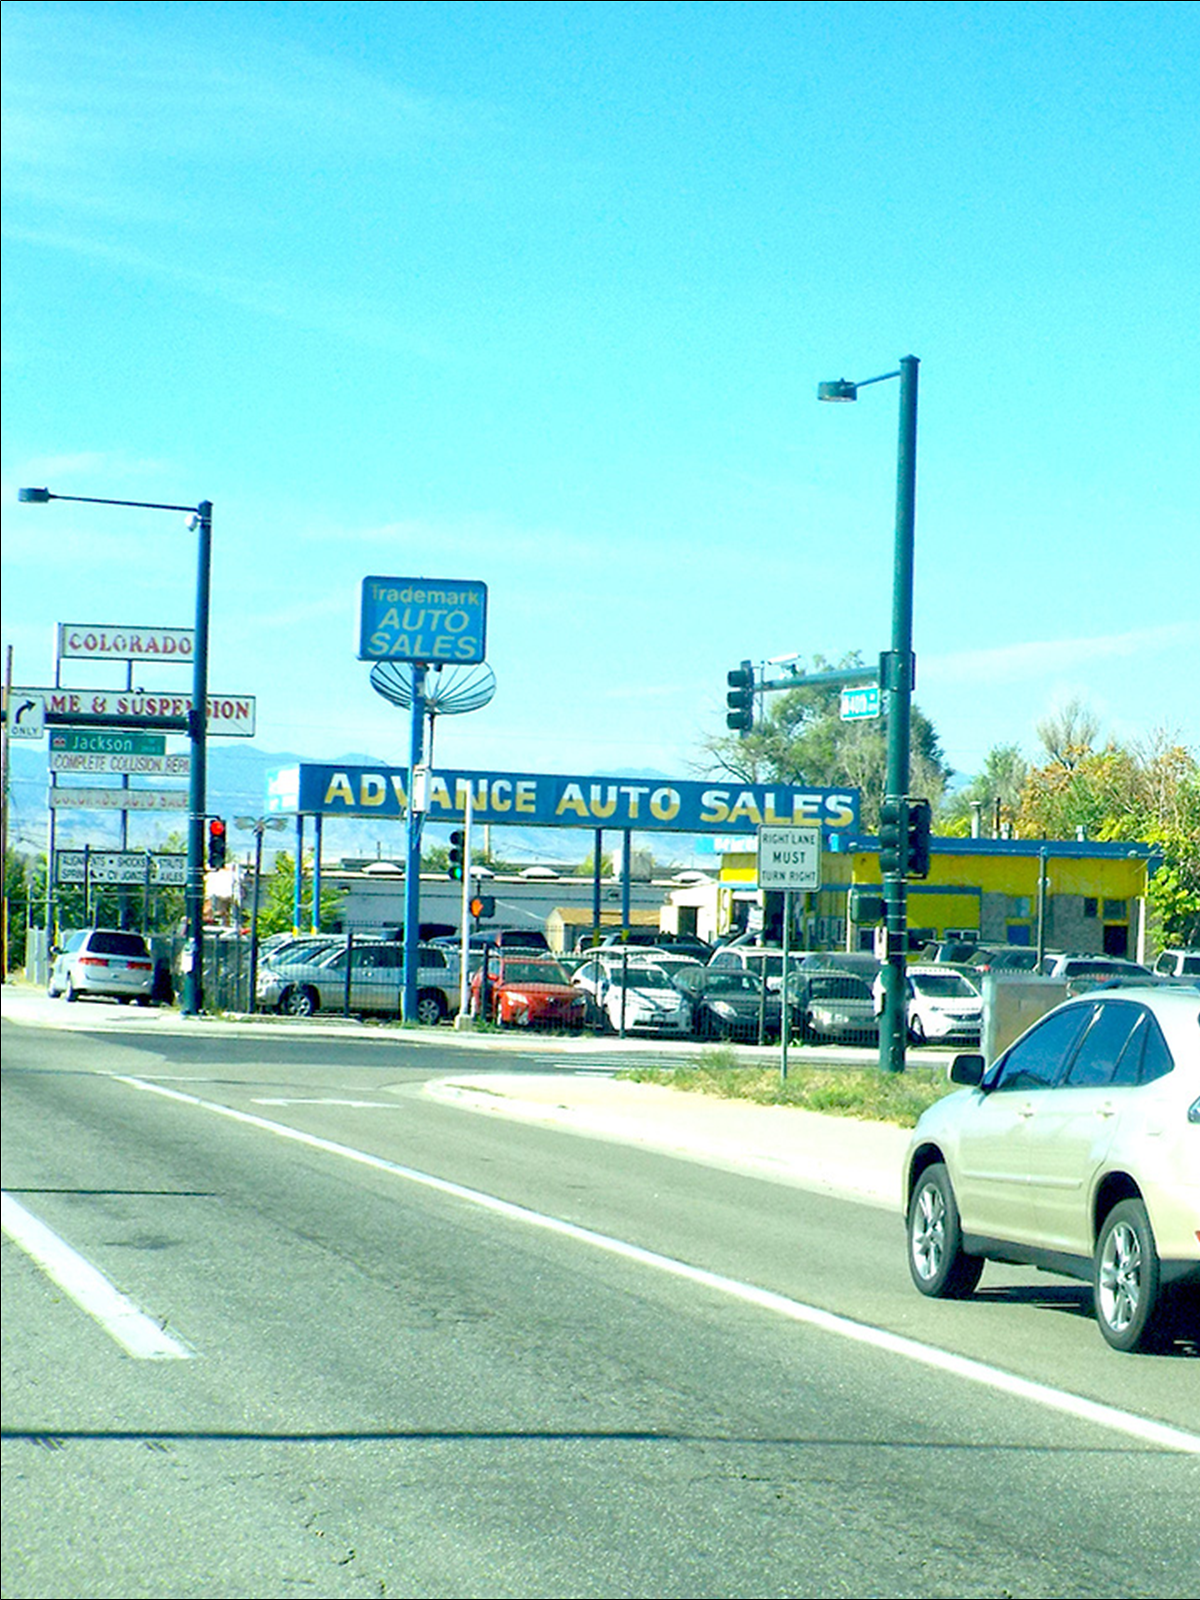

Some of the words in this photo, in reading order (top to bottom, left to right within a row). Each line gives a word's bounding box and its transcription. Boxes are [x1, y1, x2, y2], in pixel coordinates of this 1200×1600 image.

[370, 584, 480, 606] Trademark
[377, 608, 470, 633] AUTO
[68, 632, 193, 655] COLORADO
[367, 631, 477, 659] SALES
[117, 697, 250, 720] SUSPEION
[11, 726, 39, 736] ONLY
[72, 735, 133, 752] Jackson
[324, 773, 537, 813] ADVANCE
[555, 783, 681, 821] AUTO
[700, 789, 855, 827] SALES
[762, 833, 788, 845] RIGHT
[791, 834, 816, 845] LANE
[772, 850, 806, 864] MUST
[761, 870, 786, 882] TURN
[789, 871, 816, 882] RIGHT
